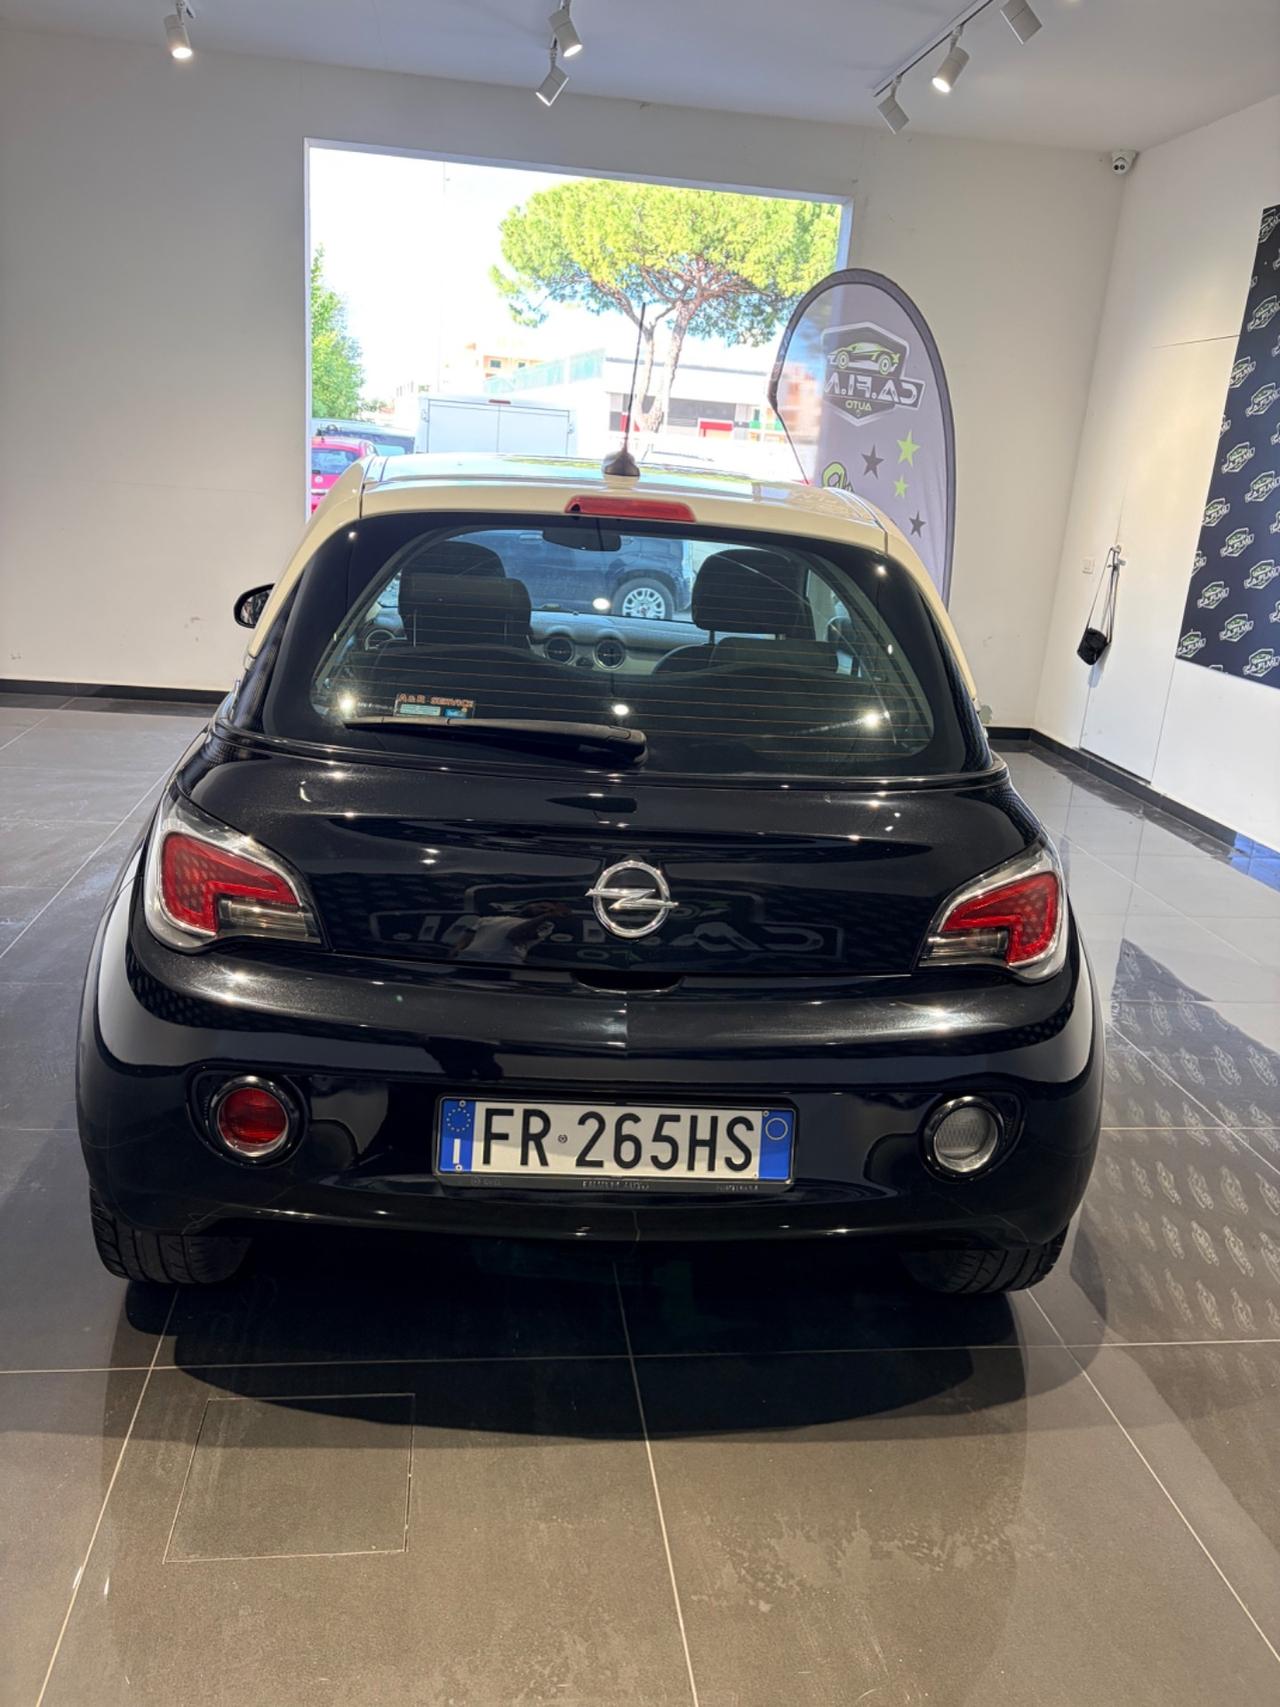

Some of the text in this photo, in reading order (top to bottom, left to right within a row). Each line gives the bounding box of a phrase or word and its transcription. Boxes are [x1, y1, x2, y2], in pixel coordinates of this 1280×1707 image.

[453, 1138, 461, 1164] I
[482, 1108, 755, 1172] FR 265HS
